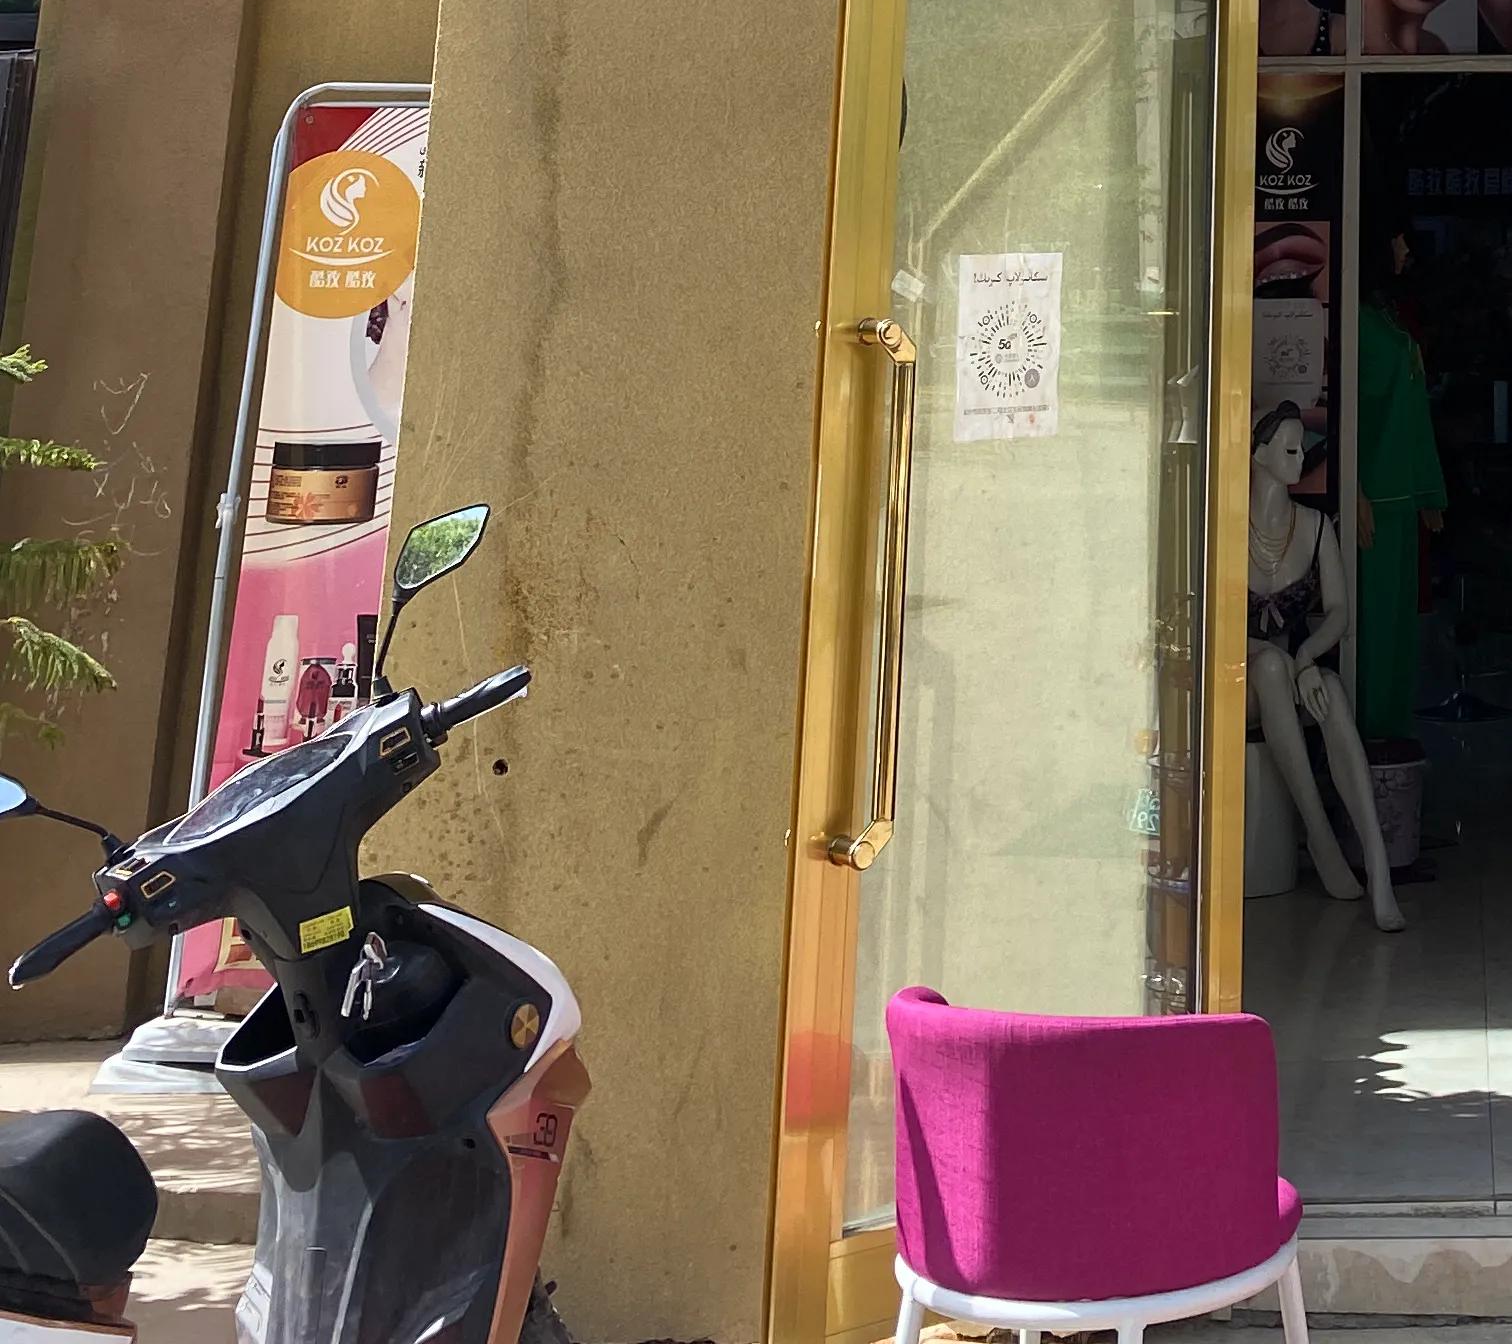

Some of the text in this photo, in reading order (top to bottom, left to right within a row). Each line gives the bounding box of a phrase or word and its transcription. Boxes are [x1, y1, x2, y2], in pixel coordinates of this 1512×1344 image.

[1259, 174, 1312, 186] KOZ KOZ
[306, 236, 385, 253] KOZ KOZ
